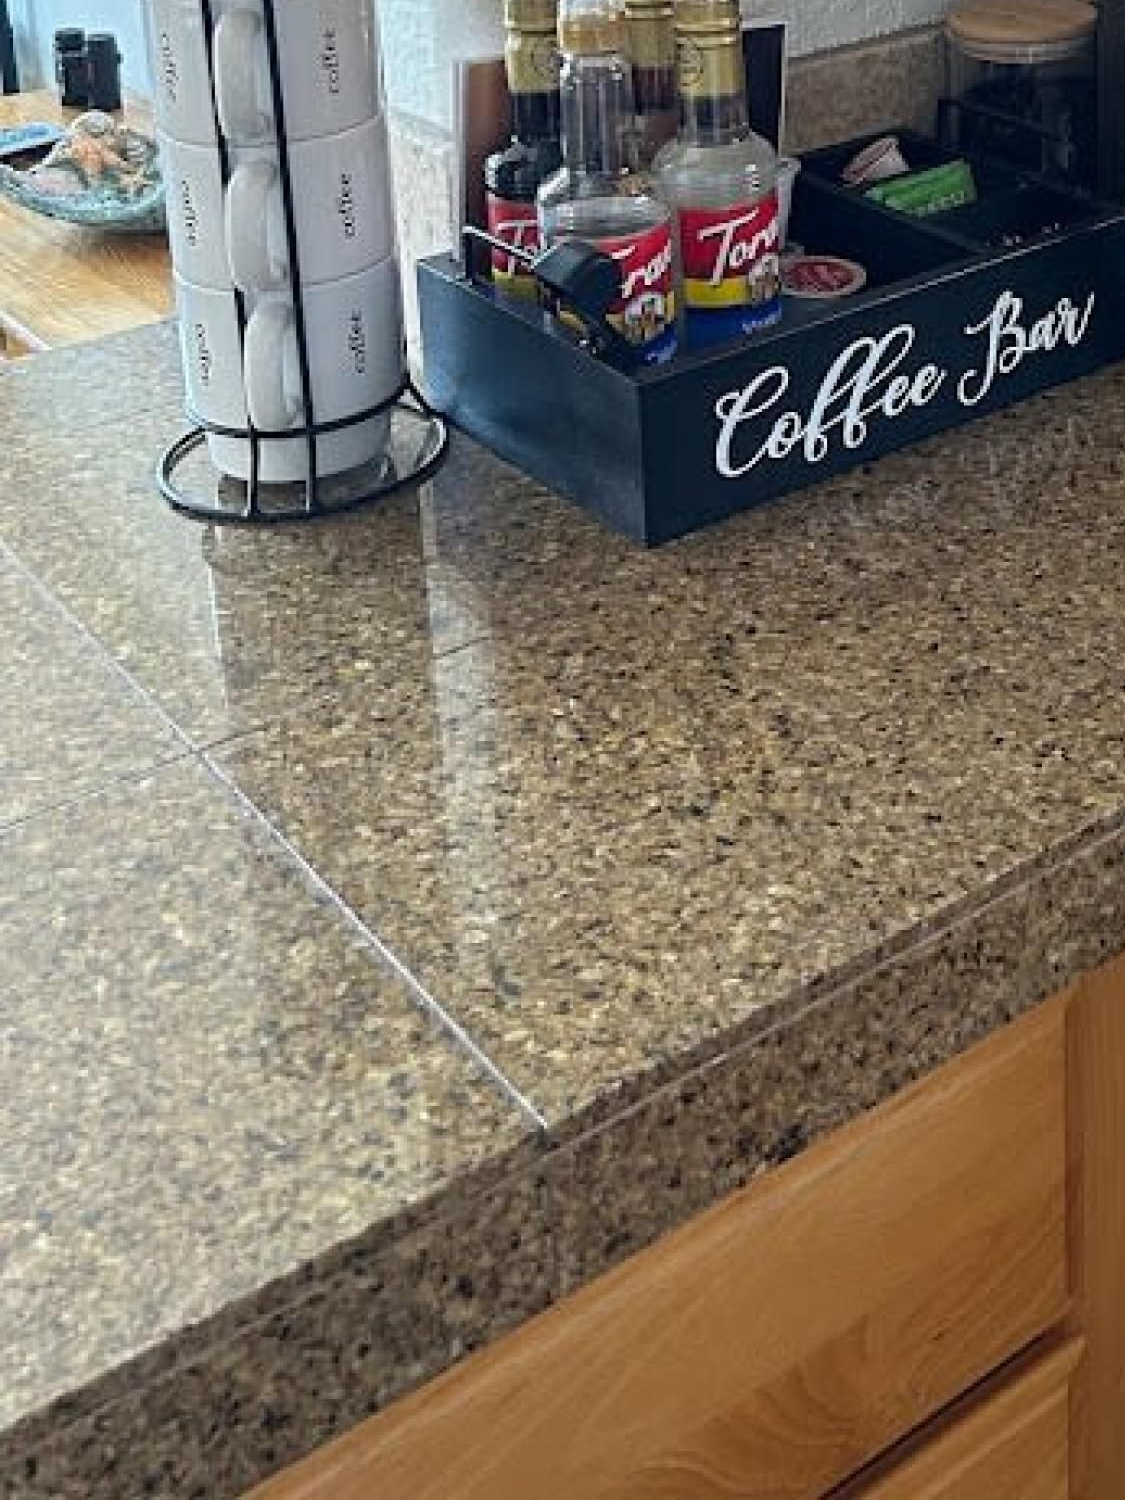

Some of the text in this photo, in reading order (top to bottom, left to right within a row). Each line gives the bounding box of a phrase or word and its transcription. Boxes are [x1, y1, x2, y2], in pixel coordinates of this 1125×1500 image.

[323, 26, 339, 94] coffee
[338, 172, 355, 238] coffee
[349, 310, 365, 374] coffee
[714, 290, 1096, 479] Coffee Bar
